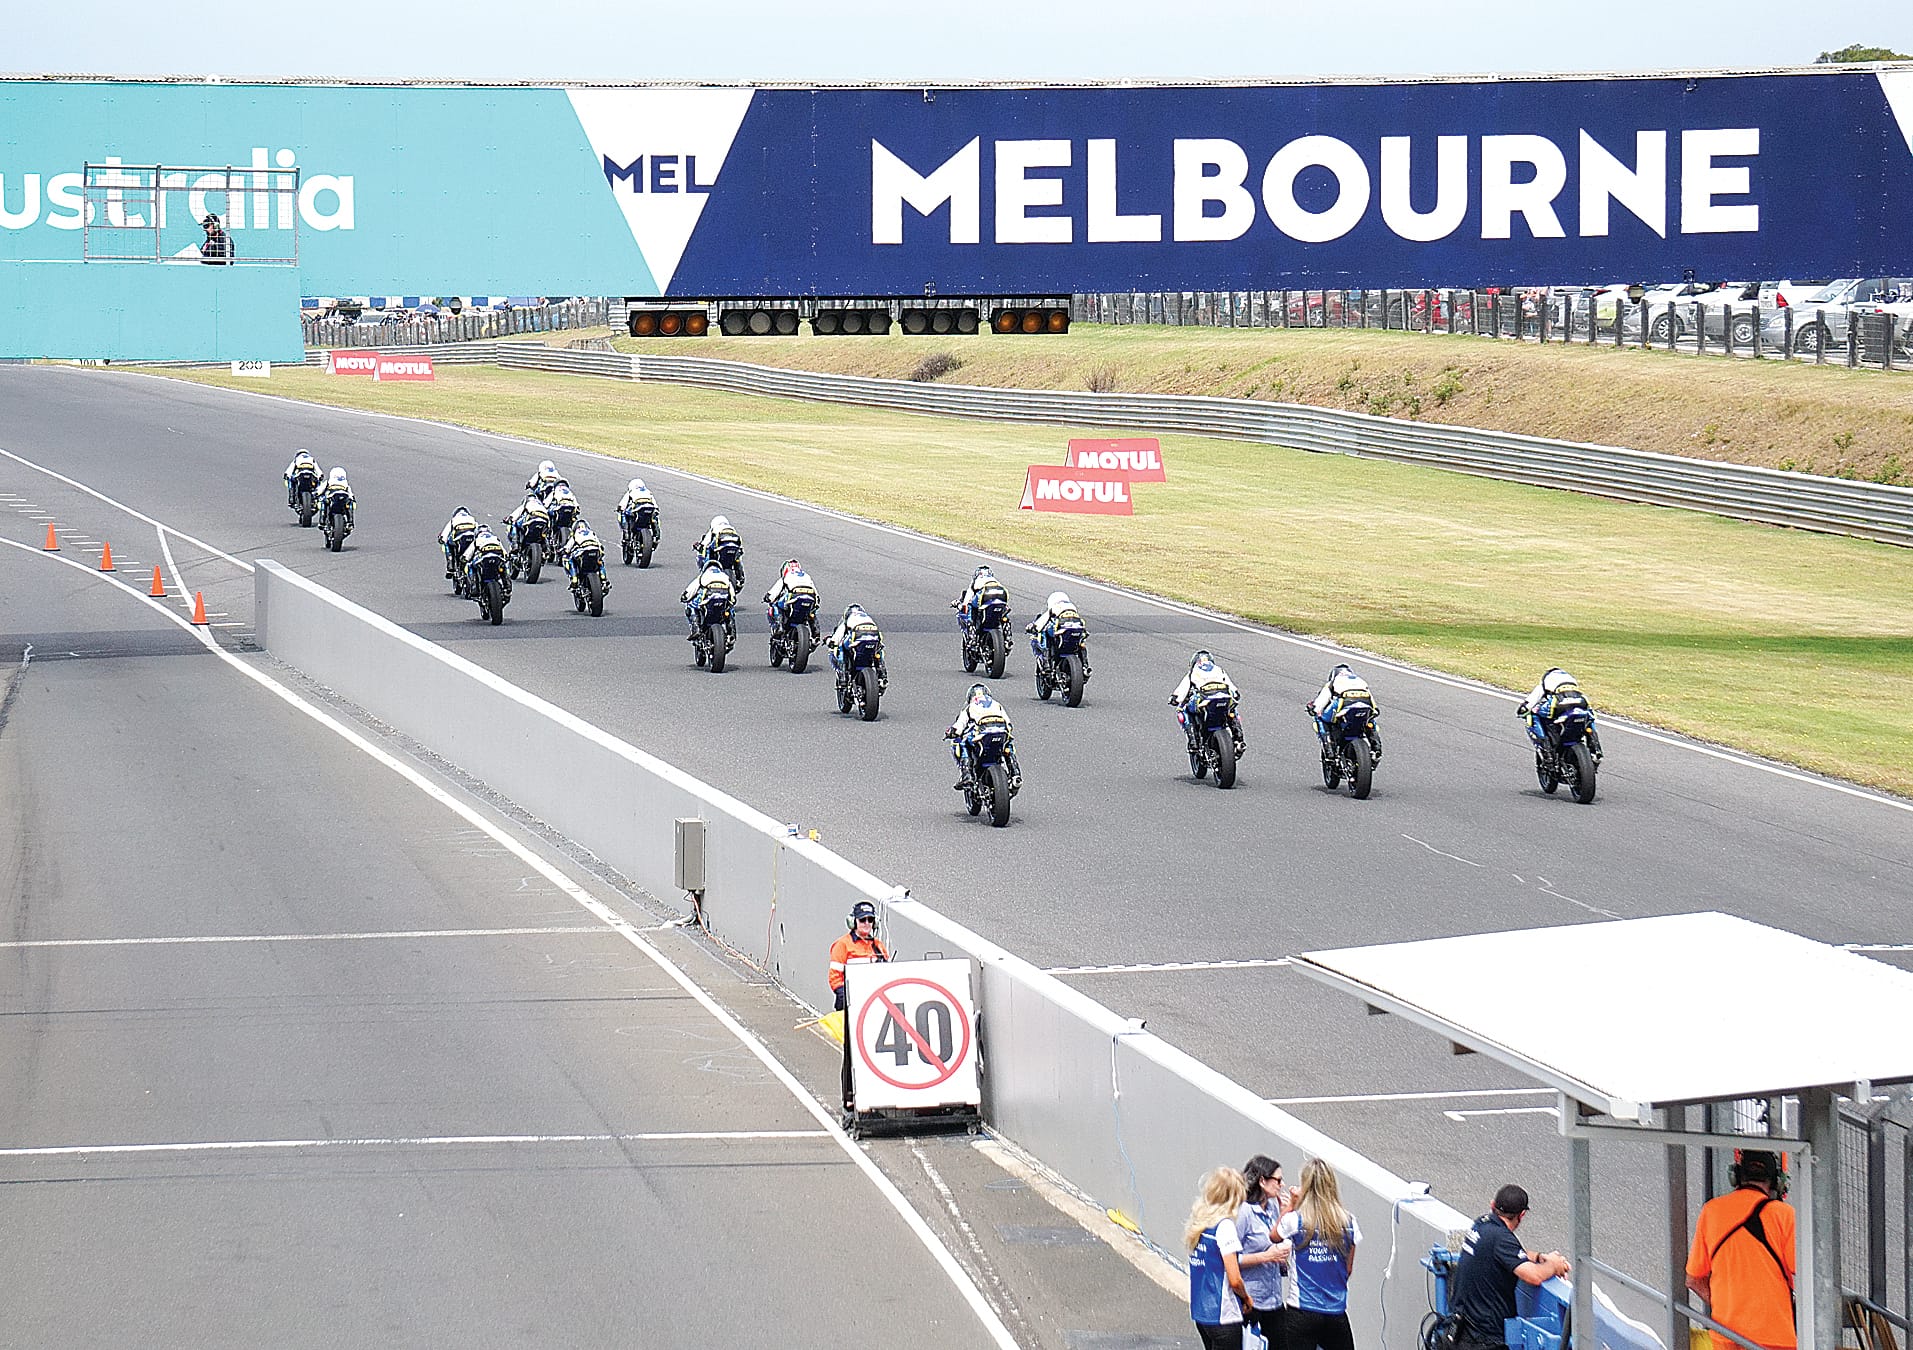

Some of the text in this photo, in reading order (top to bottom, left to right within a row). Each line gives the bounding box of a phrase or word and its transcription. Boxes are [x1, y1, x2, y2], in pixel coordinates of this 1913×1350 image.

[604, 154, 714, 193] MEL
[872, 128, 1760, 244] MELBOURNE
[238, 360, 263, 371] 200
[336, 357, 376, 370] MOTU
[380, 362, 432, 375] MOTUL
[1078, 451, 1161, 471] MOTUL
[1036, 479, 1128, 502] MOTUL
[875, 1000, 953, 1066] 40
